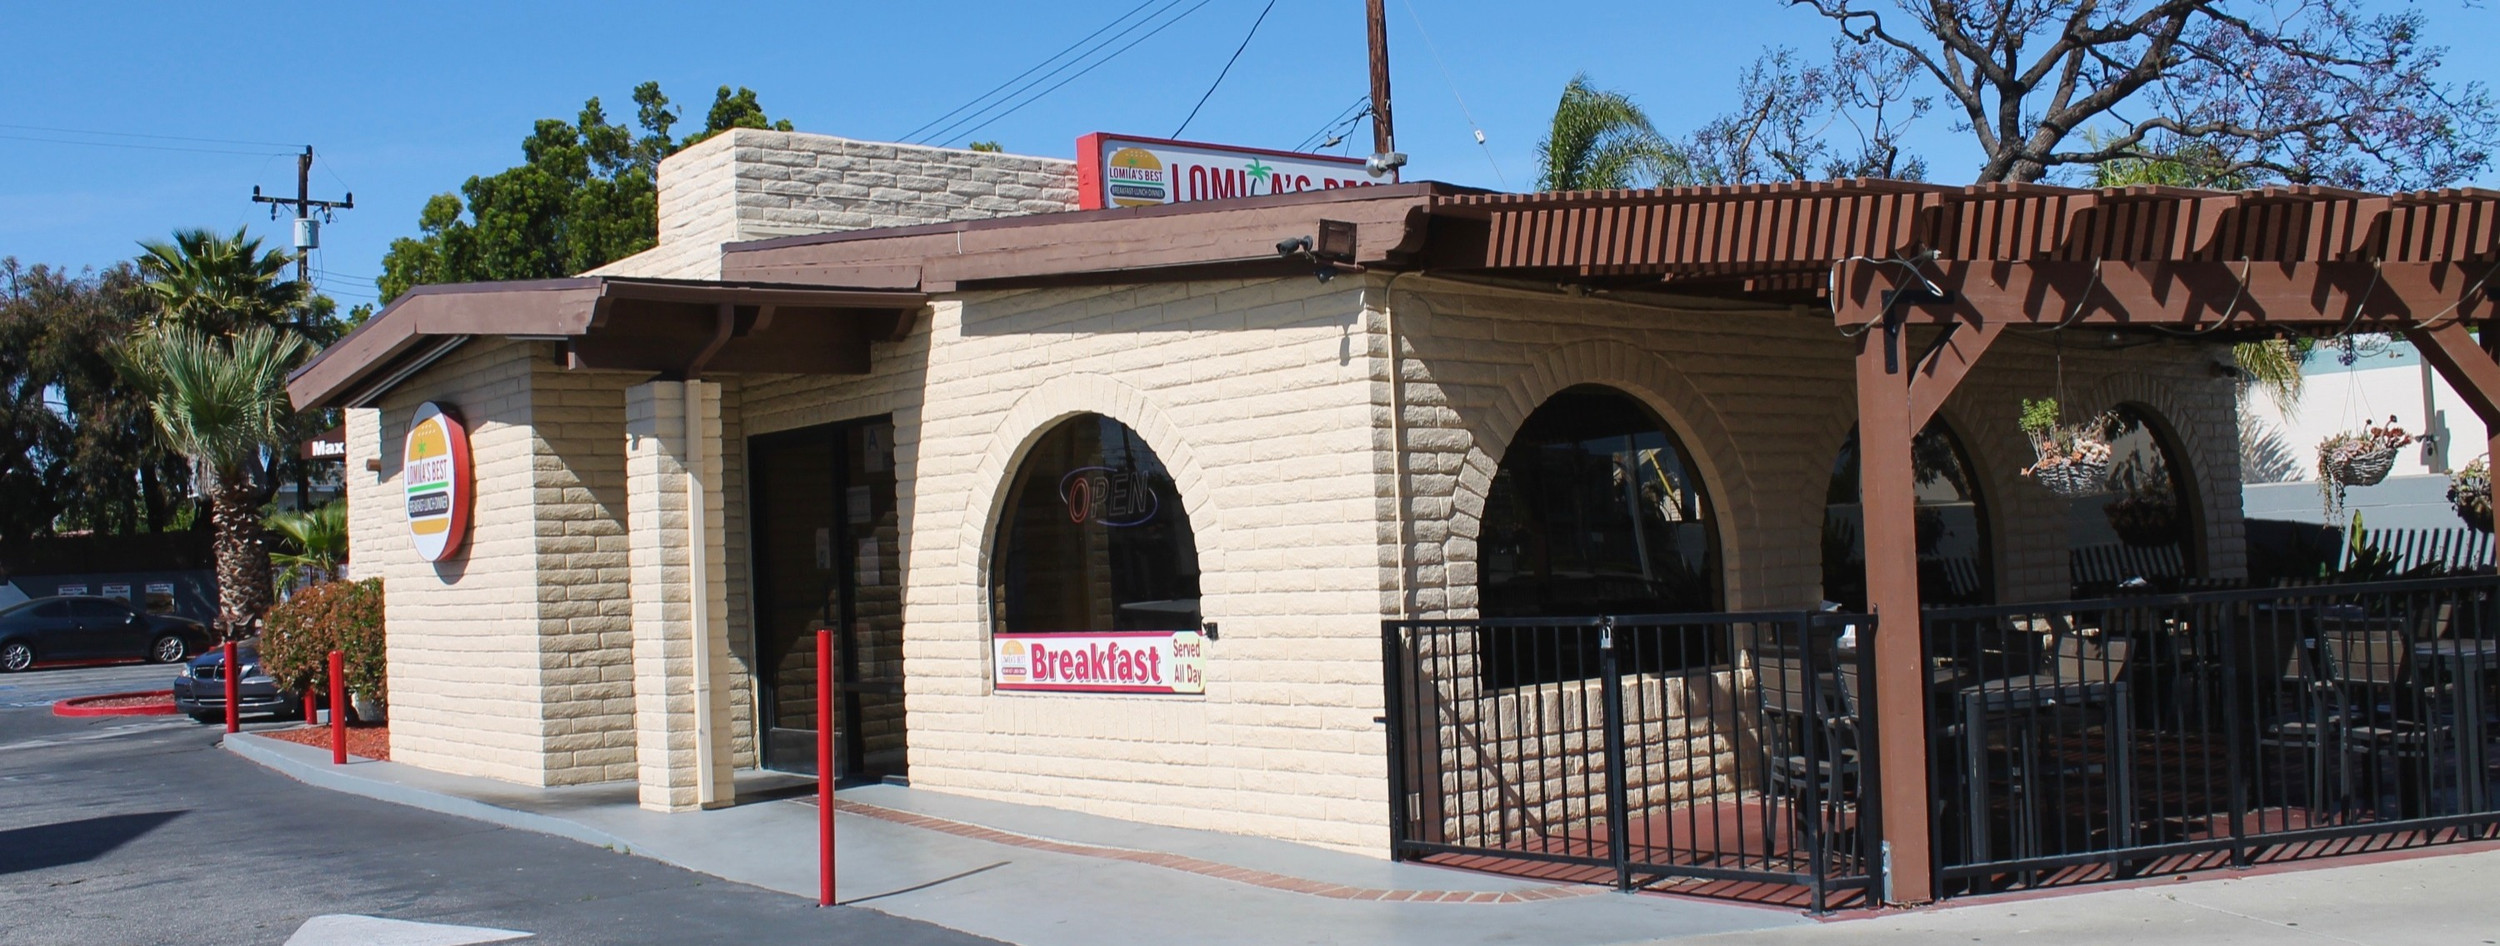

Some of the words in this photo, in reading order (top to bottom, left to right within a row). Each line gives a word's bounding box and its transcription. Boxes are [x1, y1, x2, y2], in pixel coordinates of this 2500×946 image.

[1145, 170, 1162, 182] BEST
[312, 440, 345, 456] Max
[432, 459, 447, 481] BEST
[1069, 470, 1148, 523] OPEN
[1173, 638, 1200, 658] Served
[1031, 642, 1161, 684] Breakfast
[1174, 664, 1185, 683] All
[1187, 664, 1201, 688] Day
